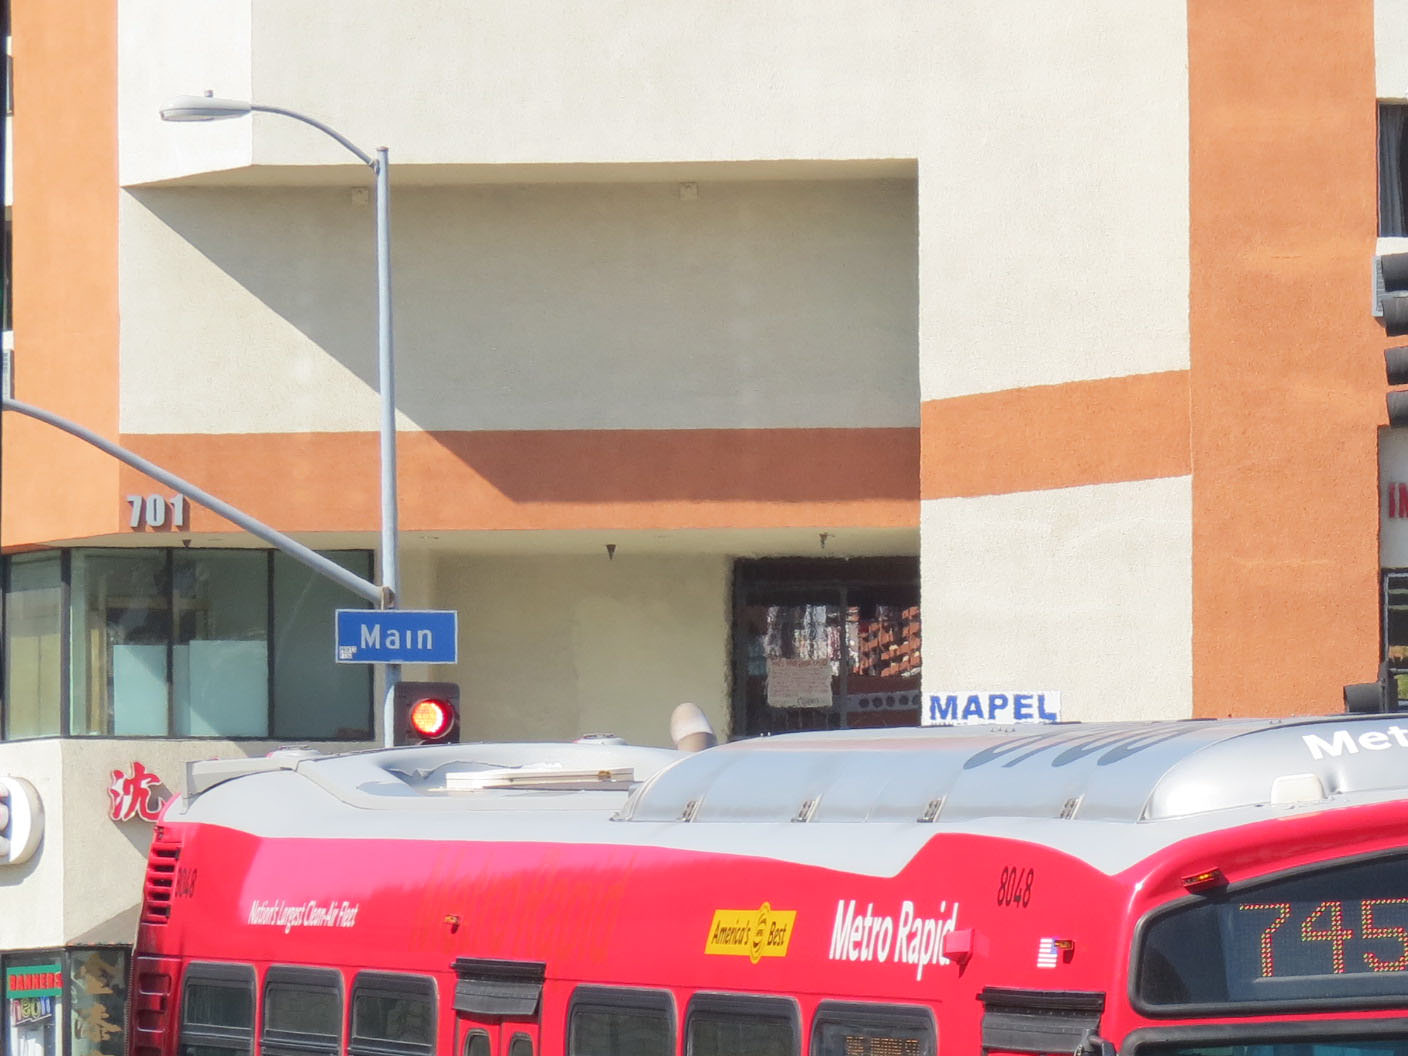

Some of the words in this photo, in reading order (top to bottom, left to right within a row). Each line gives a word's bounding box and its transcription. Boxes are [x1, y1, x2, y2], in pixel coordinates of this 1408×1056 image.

[127, 493, 184, 528] 701
[360, 623, 433, 650] Main
[929, 693, 1058, 722] MAPEL
[997, 866, 1034, 908] 8048
[710, 919, 752, 947] America's
[766, 921, 787, 947] Best
[829, 899, 893, 962] Metro
[893, 900, 960, 982] Rapid
